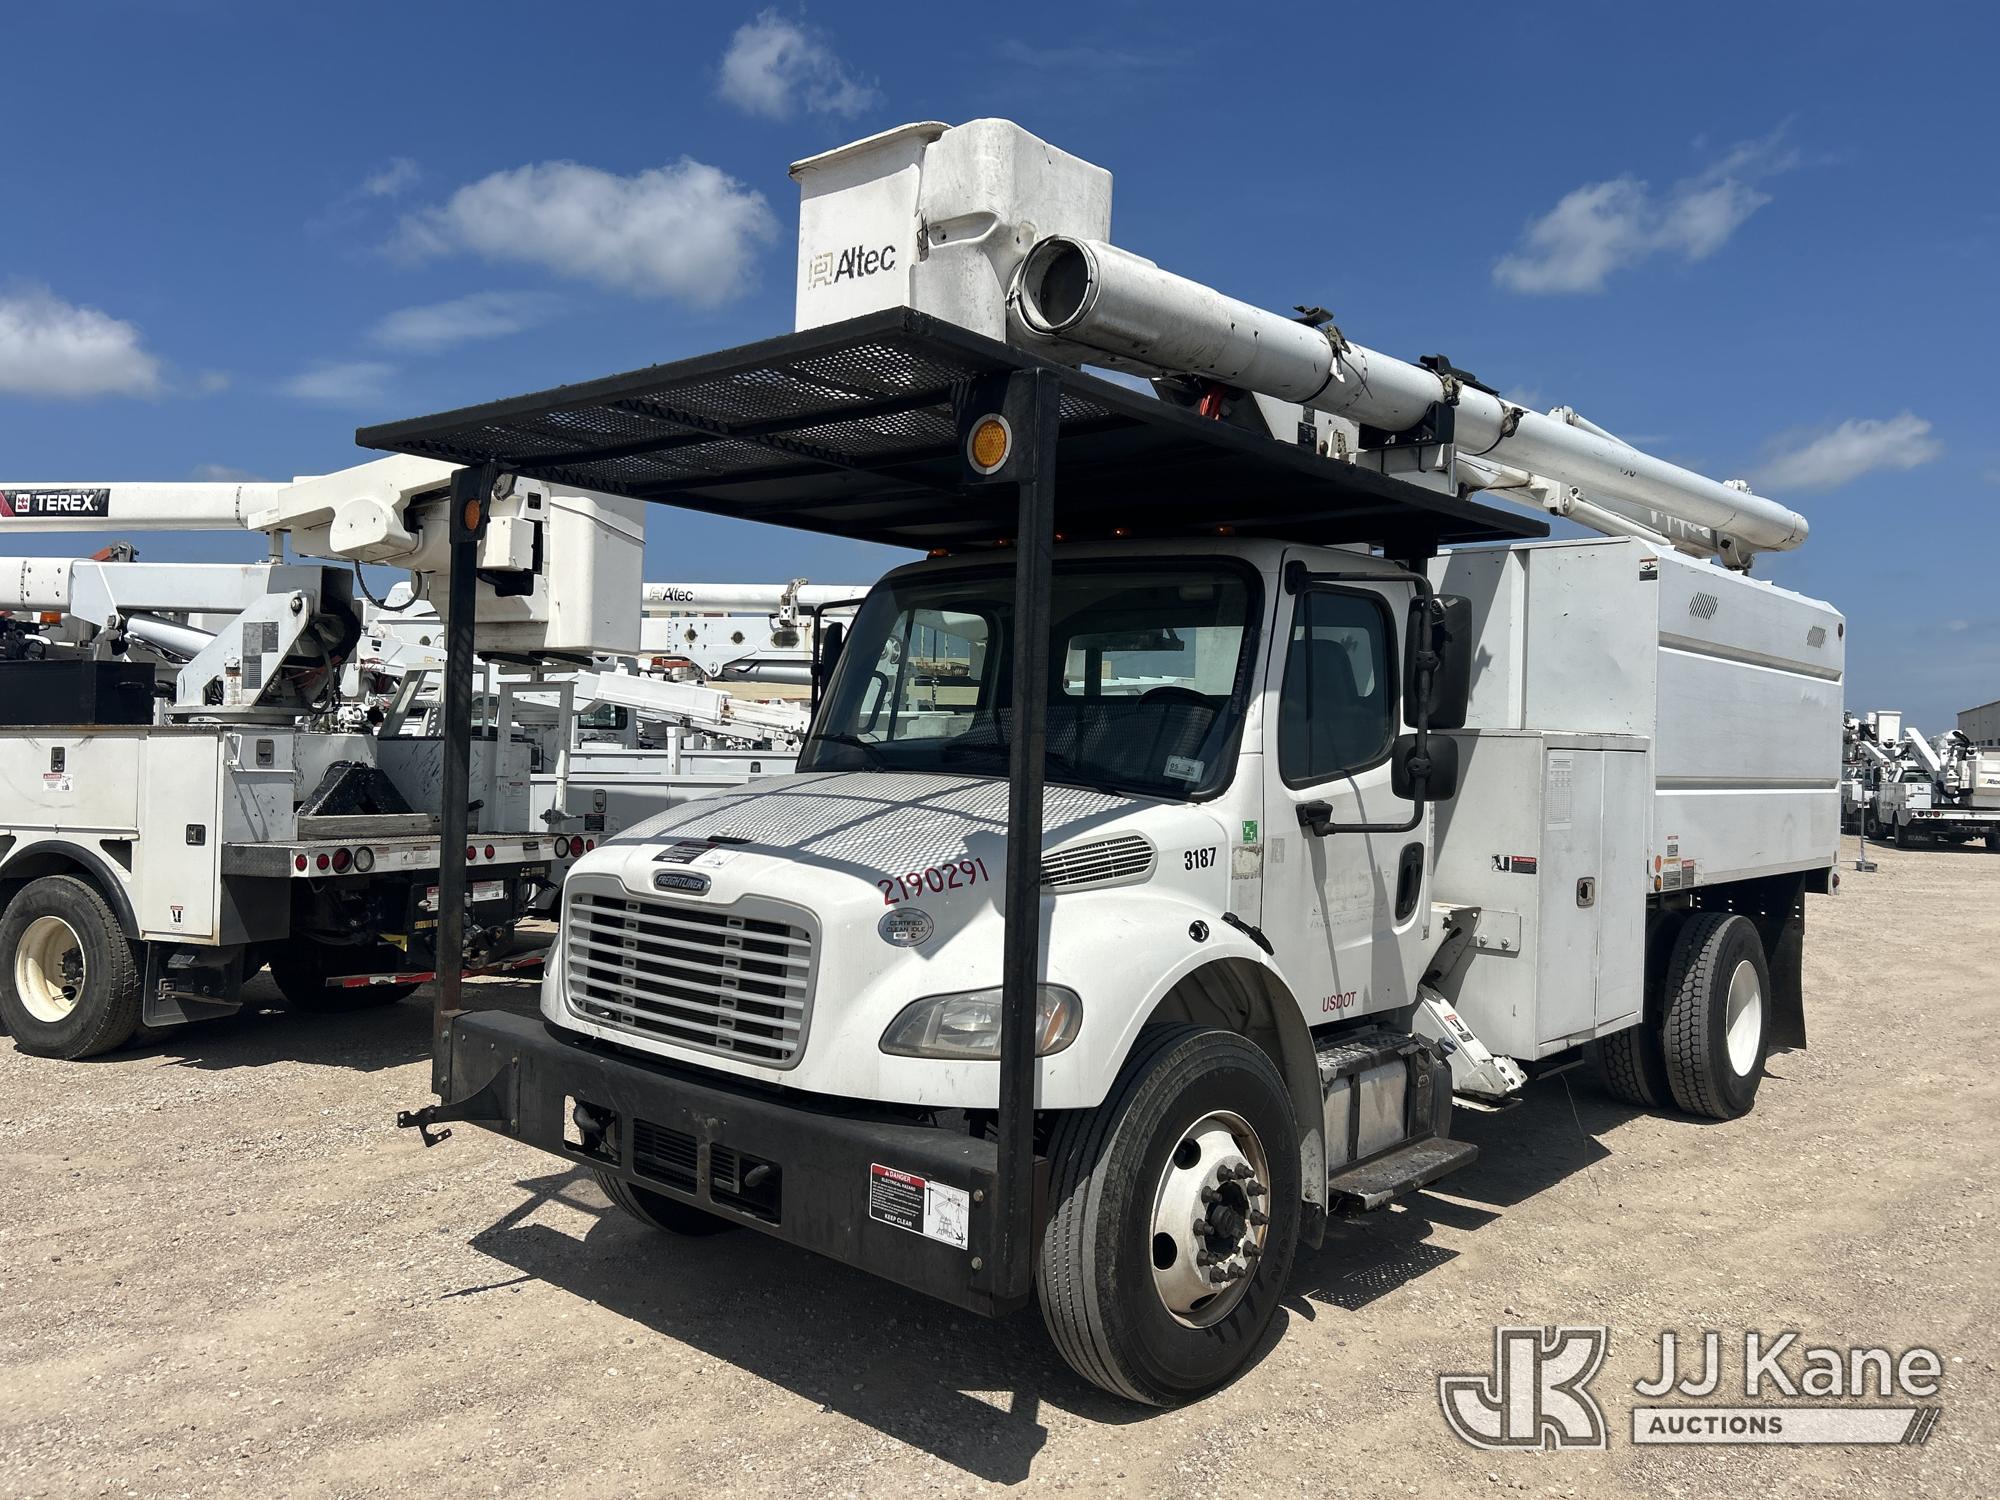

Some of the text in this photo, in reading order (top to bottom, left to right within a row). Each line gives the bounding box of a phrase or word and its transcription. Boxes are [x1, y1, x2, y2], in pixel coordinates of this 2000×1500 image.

[834, 244, 896, 284] Altec
[36, 494, 95, 512] TEREX
[662, 587, 693, 602] Altec
[1184, 847, 1217, 871] 3187
[657, 875, 703, 889] FREIGHTLINER
[877, 857, 990, 905] 2190291
[1322, 991, 1357, 1012] USDOT
[889, 1171, 911, 1183] DANGER
[884, 1213, 913, 1228] KEEP CLEAR
